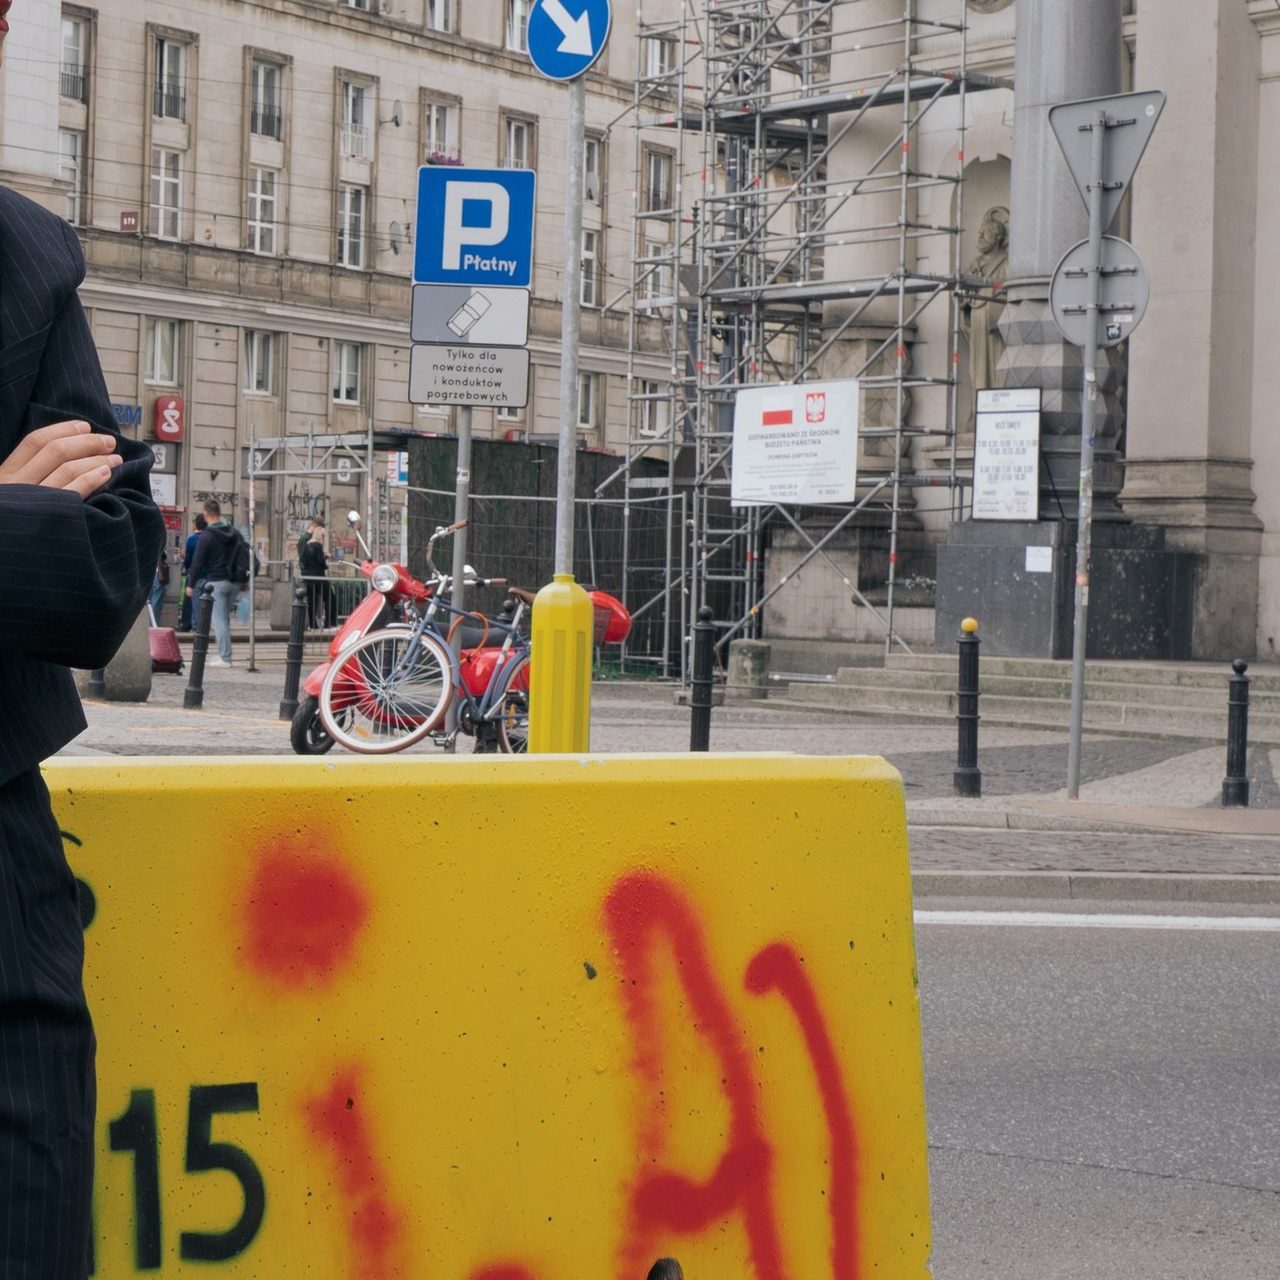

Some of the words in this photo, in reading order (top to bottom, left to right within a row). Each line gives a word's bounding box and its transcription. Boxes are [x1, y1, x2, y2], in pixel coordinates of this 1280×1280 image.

[442, 180, 510, 270] P
[463, 254, 517, 276] Płatny
[447, 349, 474, 361] Tylko
[479, 350, 496, 360] dla
[432, 363, 503, 373] nowożeńców
[442, 376, 502, 387] konduktów
[427, 390, 508, 403] pogrzebowych
[88, 1082, 267, 1276] 15
